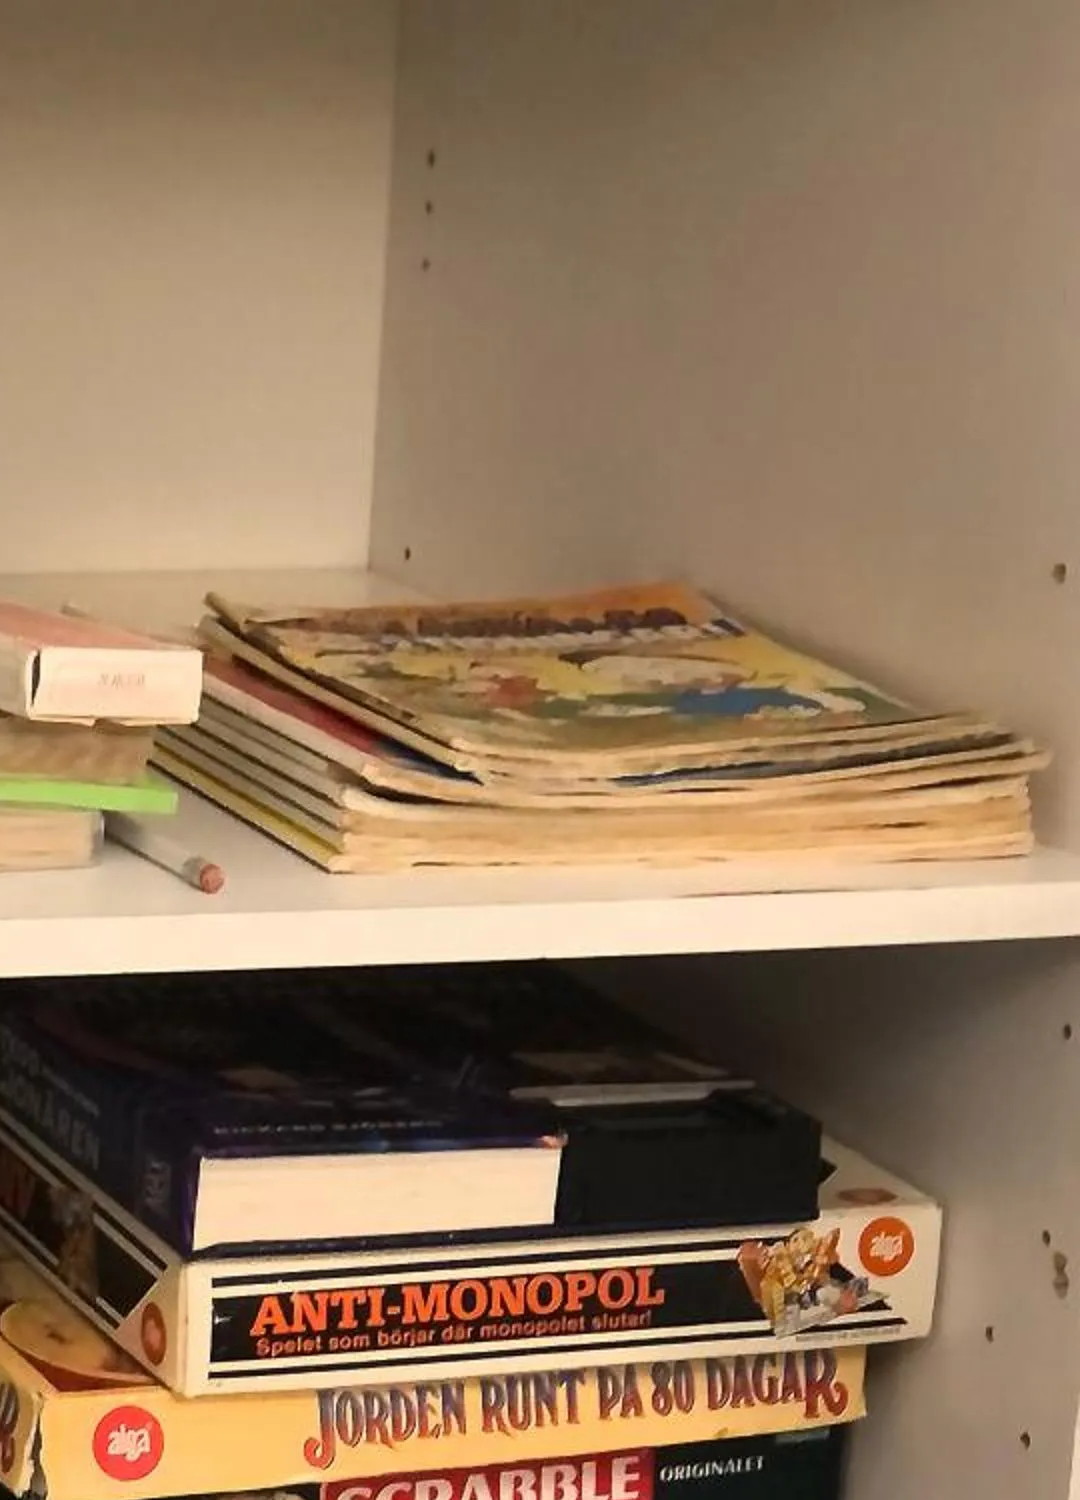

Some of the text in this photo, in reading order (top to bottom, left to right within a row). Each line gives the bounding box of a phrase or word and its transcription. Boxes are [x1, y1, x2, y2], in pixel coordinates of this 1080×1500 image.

[250, 1267, 665, 1337] ANTI-MONOPOL
[256, 1335, 322, 1358] Spelet
[328, 1333, 370, 1350] som
[377, 1329, 436, 1347] börjar
[441, 1325, 474, 1342] där
[479, 1314, 586, 1338] monopolet
[303, 1379, 467, 1470] JORDEN
[480, 1367, 585, 1438] RUNT
[651, 1359, 695, 1417] 80
[705, 1348, 850, 1419] DAGAR
[659, 1455, 765, 1485] ORIGINALET
